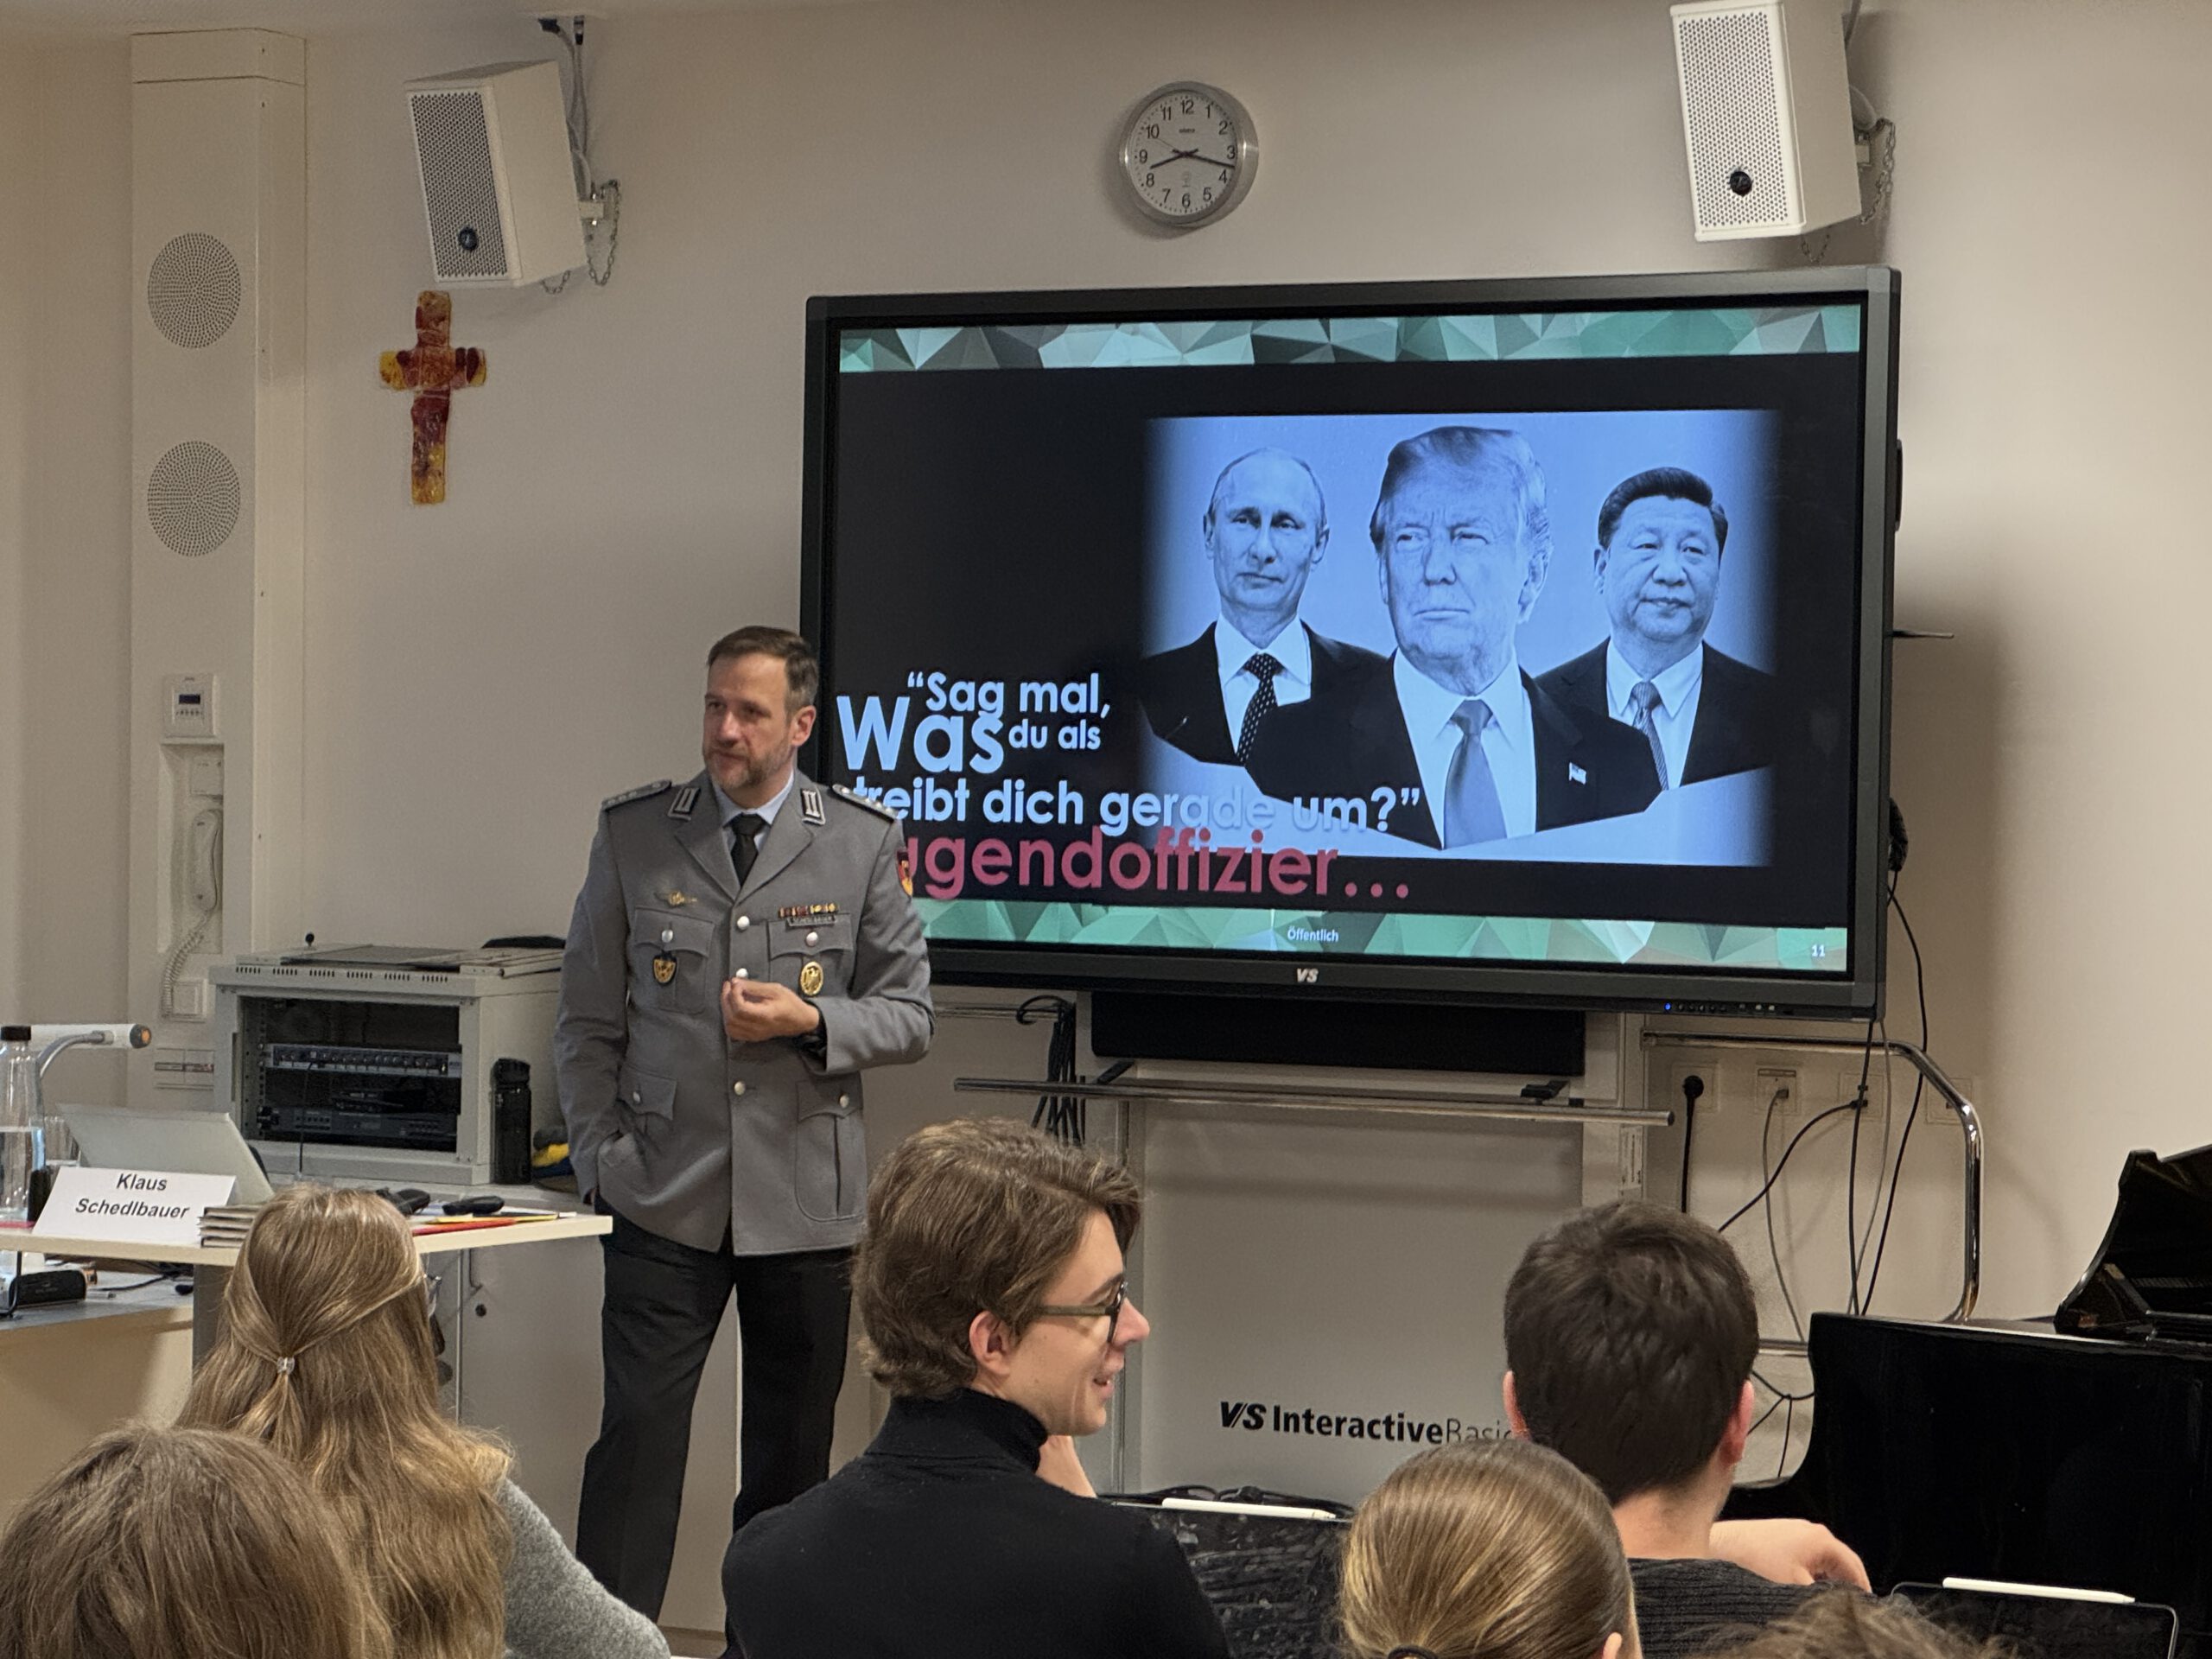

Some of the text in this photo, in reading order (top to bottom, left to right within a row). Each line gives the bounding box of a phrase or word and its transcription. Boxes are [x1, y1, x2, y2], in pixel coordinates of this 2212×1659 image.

[1161, 106, 1172, 121] 11
[1180, 99, 1194, 115] 12
[1147, 124, 1160, 139] 10
[1218, 120, 1228, 135] 2
[1139, 149, 1147, 163] 9
[1226, 144, 1236, 159] 3
[1146, 173, 1154, 188] 8
[1218, 168, 1228, 183] 4
[1162, 188, 1171, 203] 7
[1181, 193, 1191, 207] 6
[1203, 187, 1211, 201] 5
[1020, 672, 1110, 719] mal,
[836, 696, 1004, 774] Was
[1008, 719, 1101, 750] du als
[982, 779, 1084, 824] dich
[1100, 785, 1275, 836] gerade
[1287, 925, 1339, 943] Öffentlich
[1811, 944, 1826, 958] 11
[1297, 968, 1319, 982] VS
[117, 1173, 168, 1192] Klaus
[75, 1198, 190, 1219] Schedlbauer
[1220, 1401, 1267, 1431] VS
